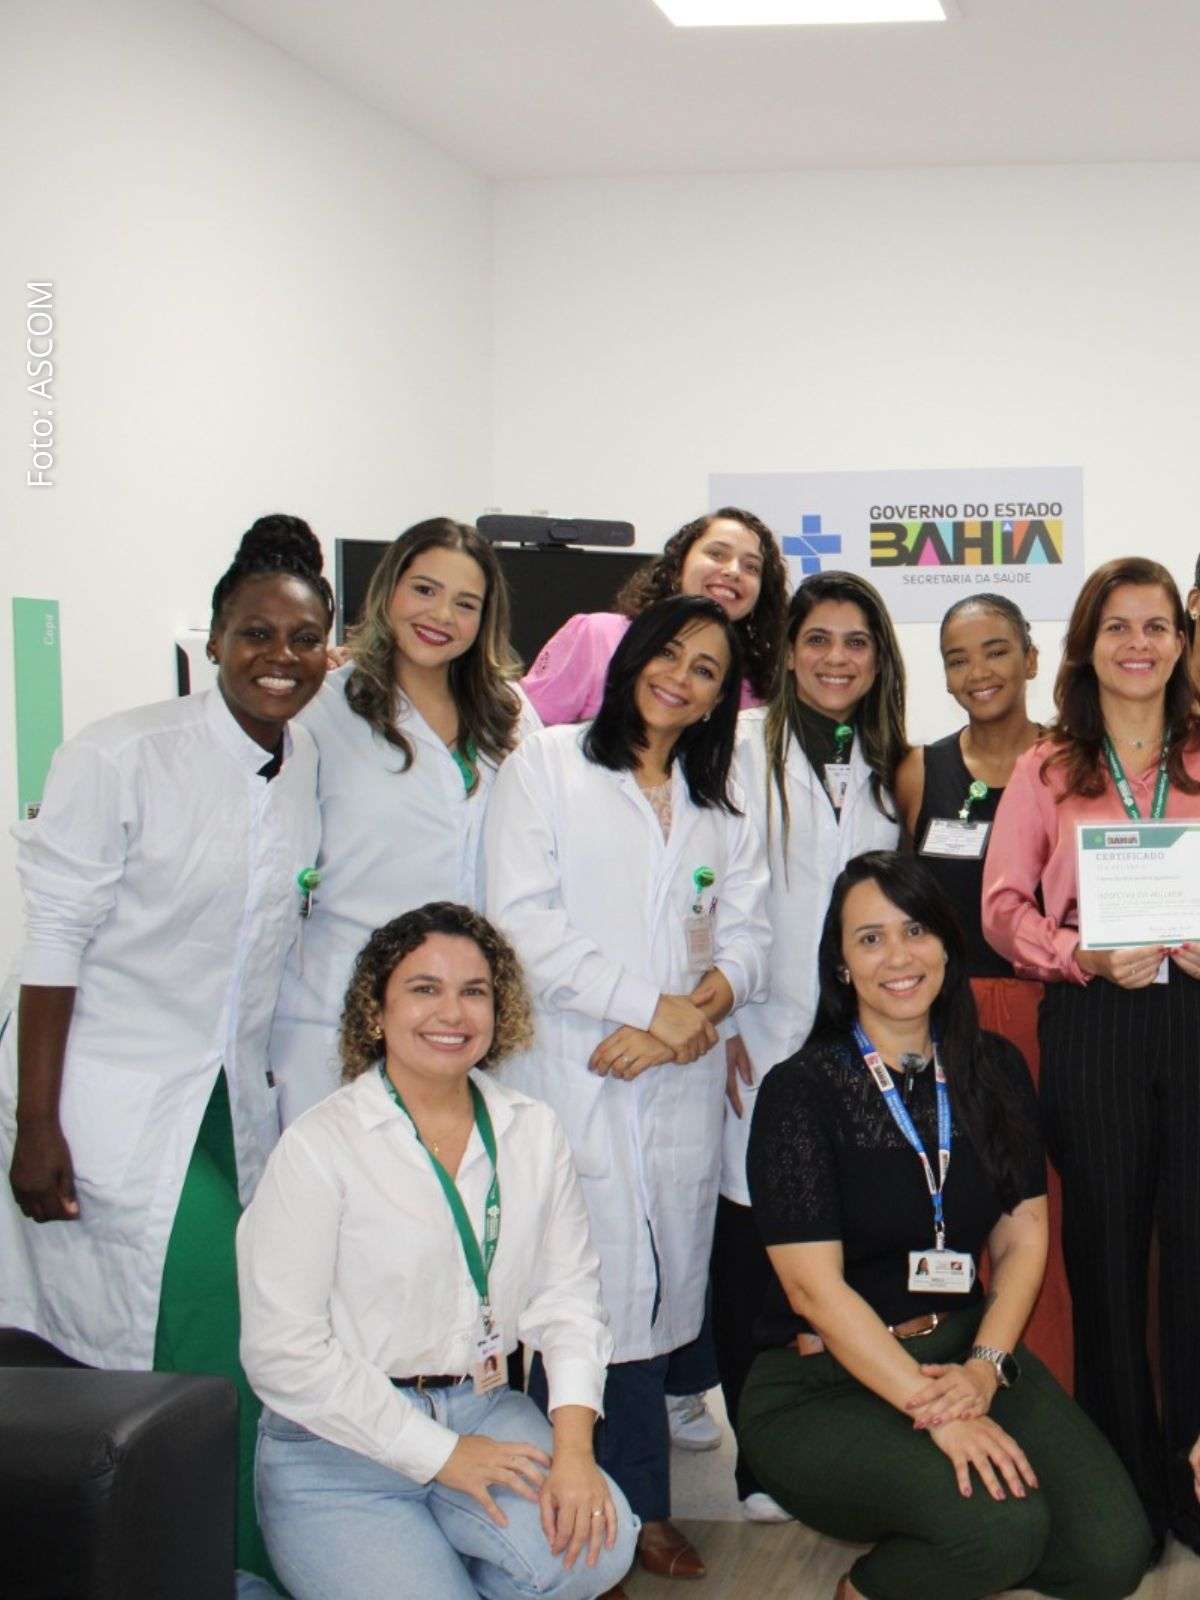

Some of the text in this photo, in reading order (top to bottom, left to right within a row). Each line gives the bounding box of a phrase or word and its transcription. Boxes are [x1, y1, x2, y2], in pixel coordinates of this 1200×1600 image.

[869, 502, 1062, 520] GOVERNO DO ESTADO
[870, 520, 1063, 567] BAHIA
[902, 573, 972, 585] SECRETARIA
[975, 574, 991, 584] DA
